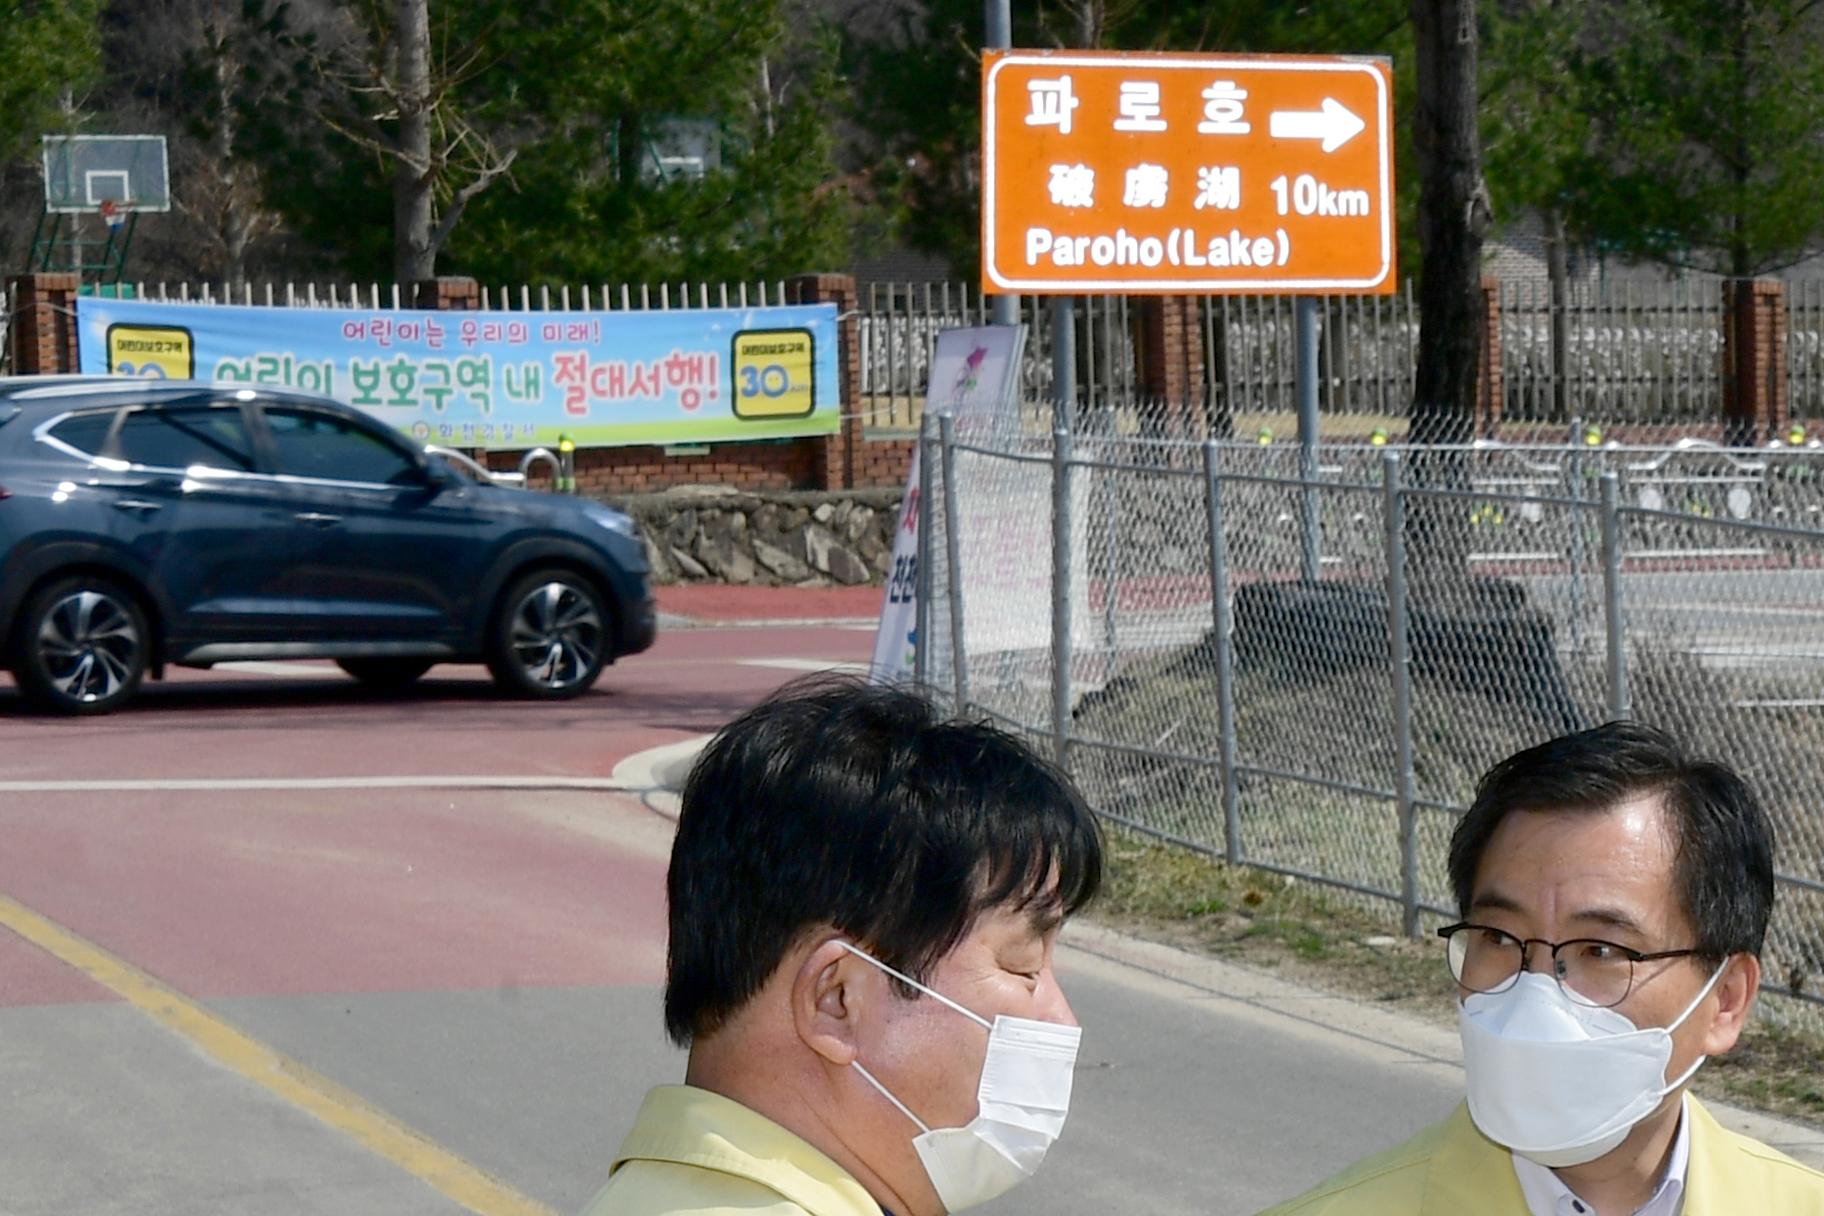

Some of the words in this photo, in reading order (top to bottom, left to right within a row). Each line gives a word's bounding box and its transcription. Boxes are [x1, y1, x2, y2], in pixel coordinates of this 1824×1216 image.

[1024, 75, 1251, 135] 파로호
[1270, 173, 1370, 217] 10km
[1025, 226, 1290, 267] Paroho(Lake)
[343, 319, 444, 347] 어린이는
[461, 320, 527, 346] 우리의
[543, 320, 599, 343] 미래!
[351, 357, 491, 412] 보호구역
[505, 363, 540, 399] 내
[554, 352, 717, 415] 절대서행!
[740, 365, 789, 398] 30
